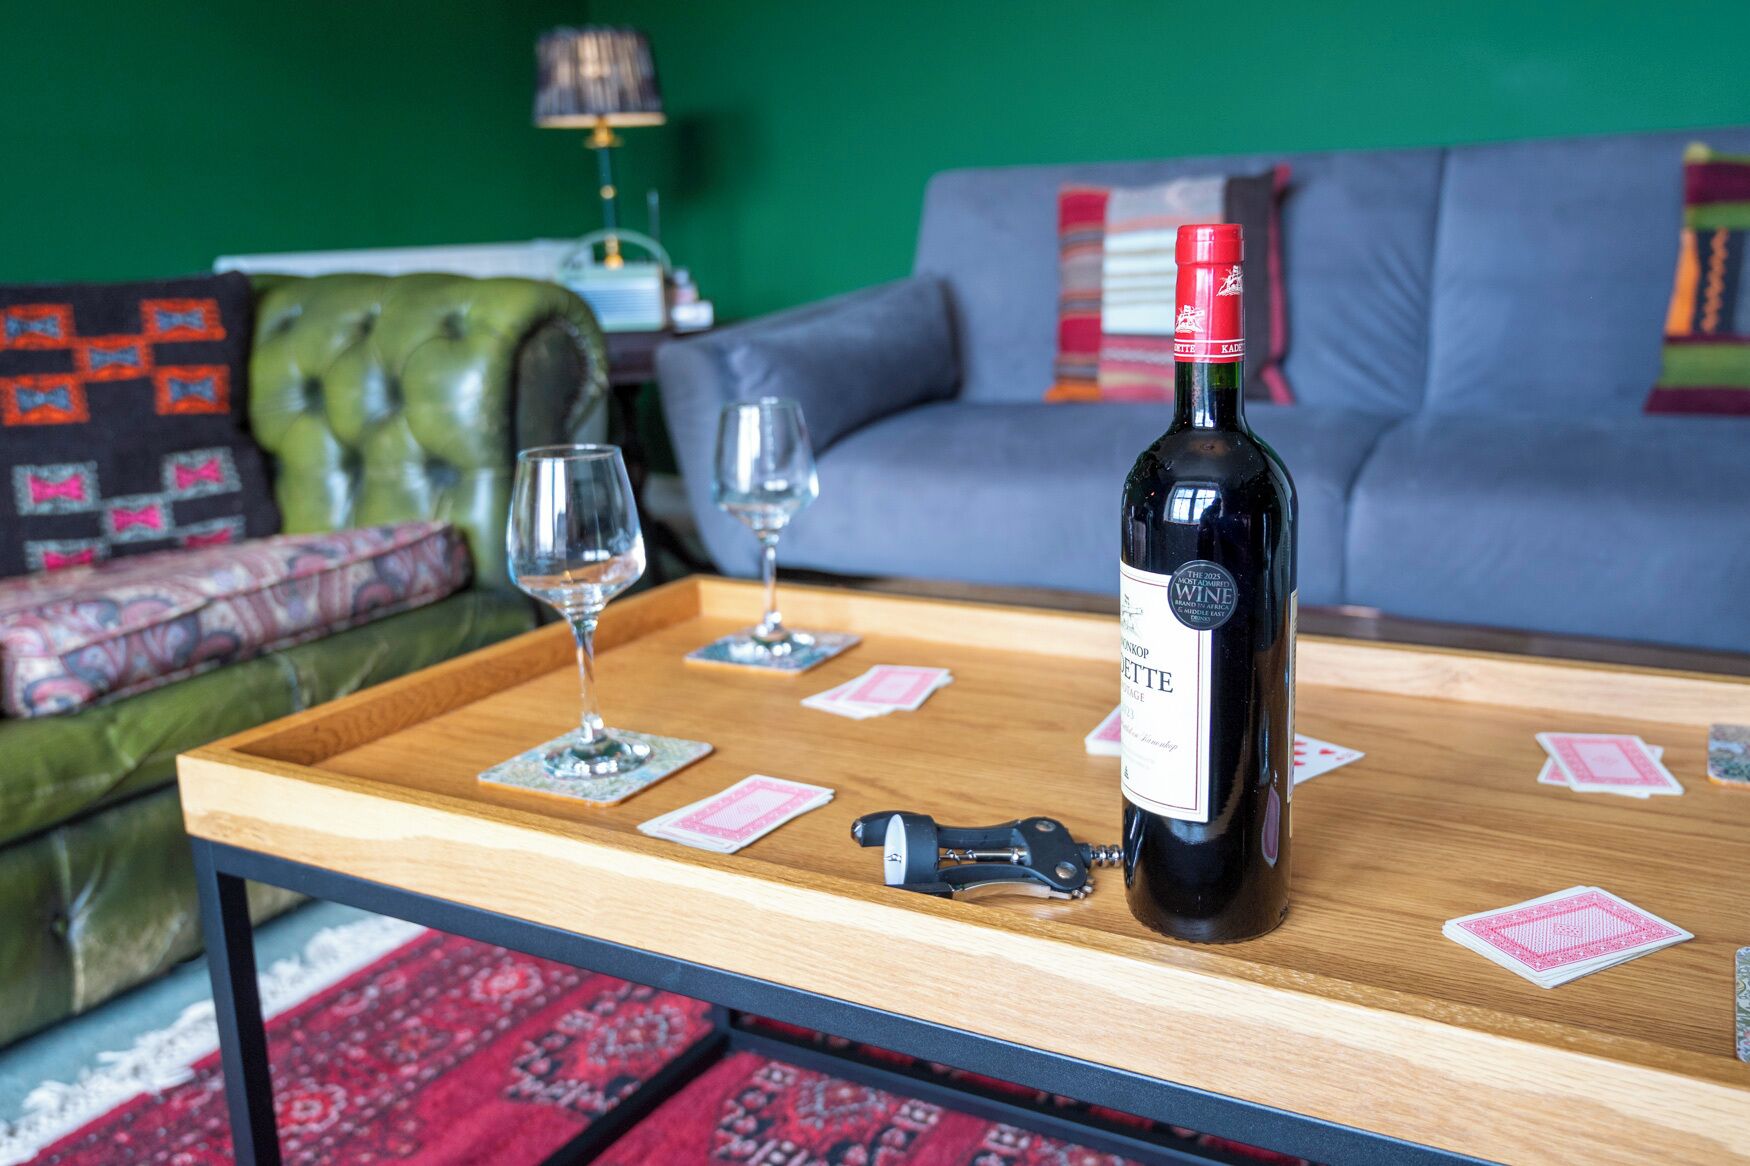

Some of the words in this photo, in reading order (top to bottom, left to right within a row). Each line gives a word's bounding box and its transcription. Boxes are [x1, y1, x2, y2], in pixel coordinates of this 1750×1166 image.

[1220, 343, 1245, 354] KADE
[1187, 570, 1203, 579] THE
[1178, 577, 1197, 585] MOST
[1197, 579, 1230, 587] ADMIRED
[1175, 583, 1233, 604] WINE
[1175, 599, 1197, 607] BRAND
[1183, 608, 1209, 616] MIDDLE
